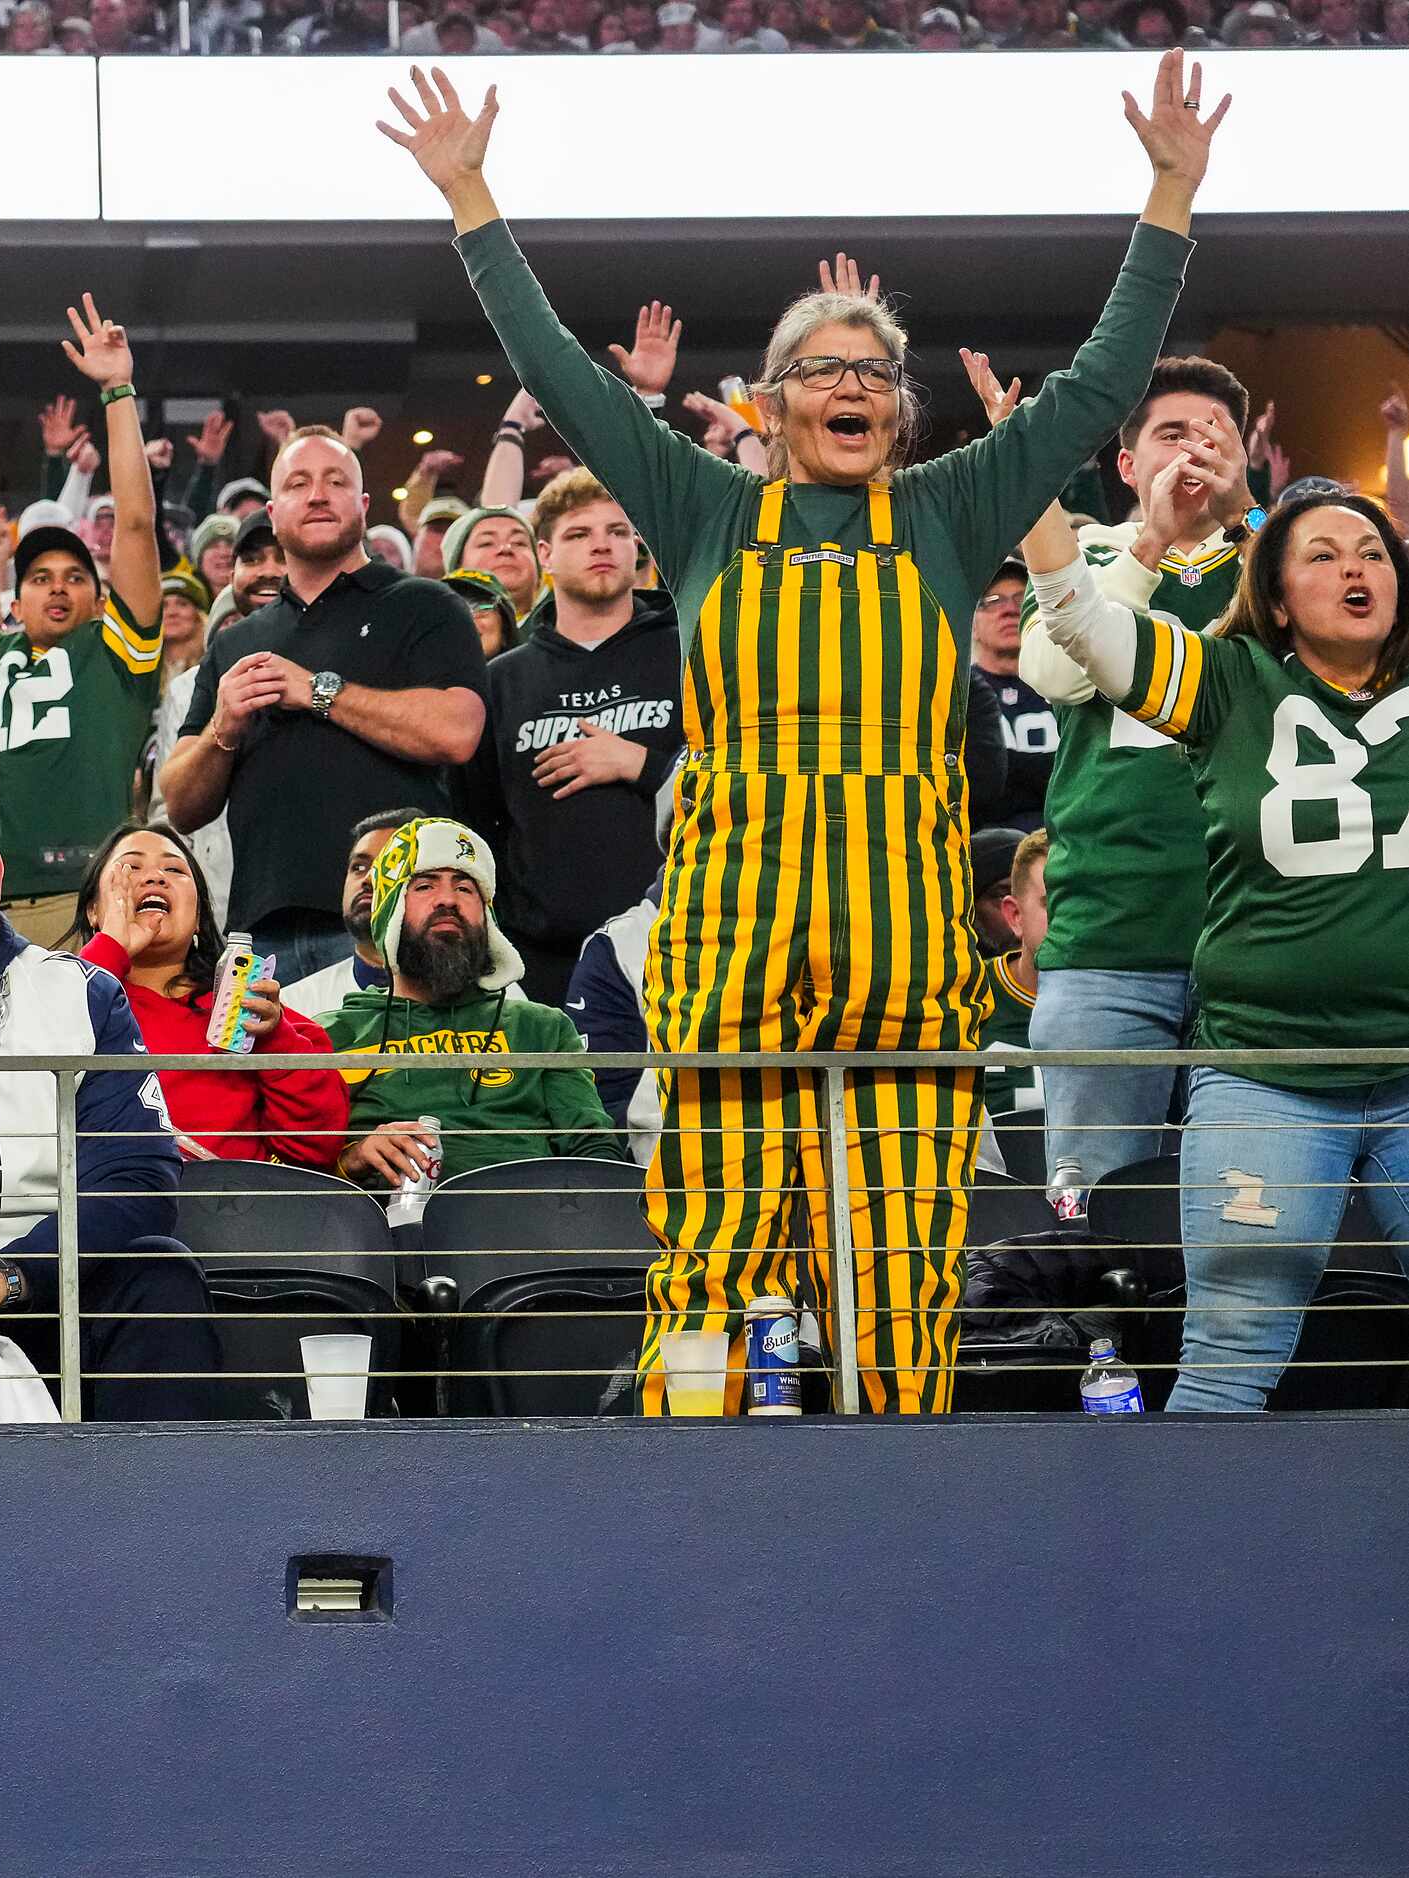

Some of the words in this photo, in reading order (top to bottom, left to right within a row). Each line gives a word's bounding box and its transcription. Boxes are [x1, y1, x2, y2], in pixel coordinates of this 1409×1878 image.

[1184, 574, 1200, 582] NFL
[559, 684, 622, 707] TEXAS
[764, 1333, 792, 1351] BLUE
